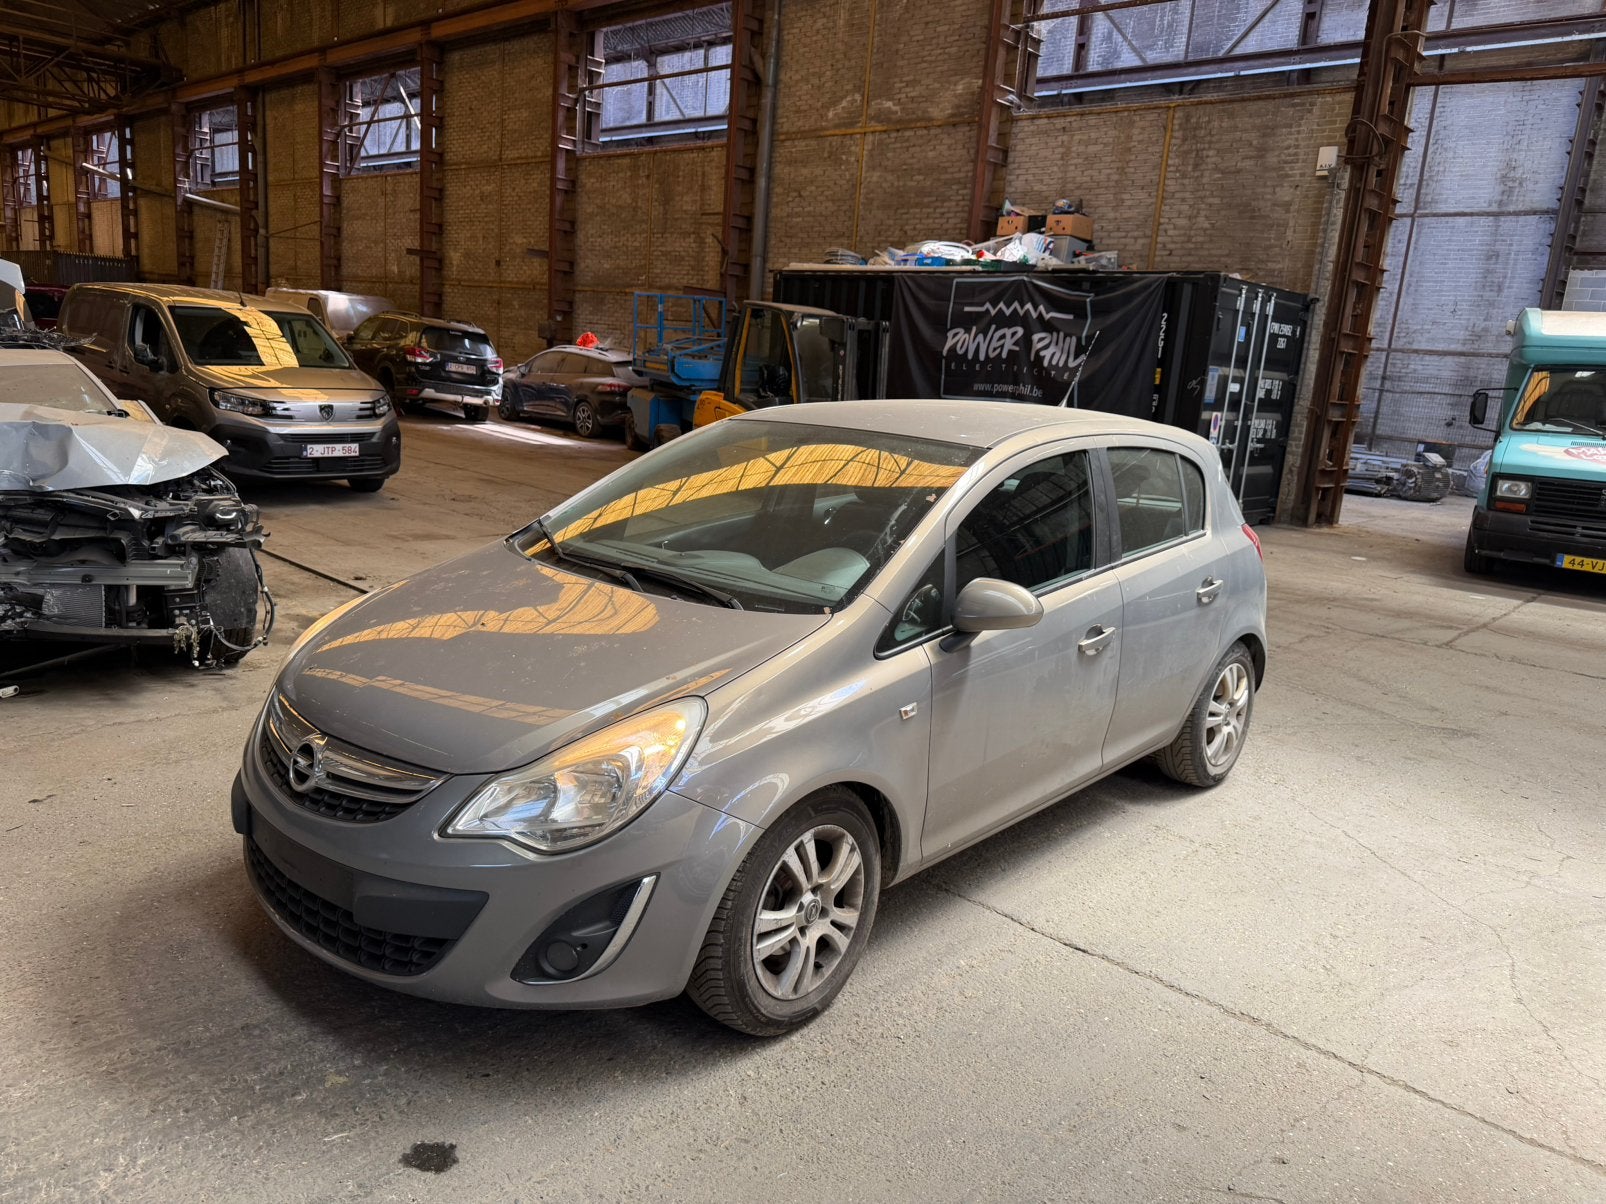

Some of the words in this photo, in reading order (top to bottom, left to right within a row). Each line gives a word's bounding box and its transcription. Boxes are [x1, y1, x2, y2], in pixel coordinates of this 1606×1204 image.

[942, 324, 1024, 361] POWER
[1030, 331, 1086, 368] PHIL
[973, 382, 1043, 398] www.powerphil.be
